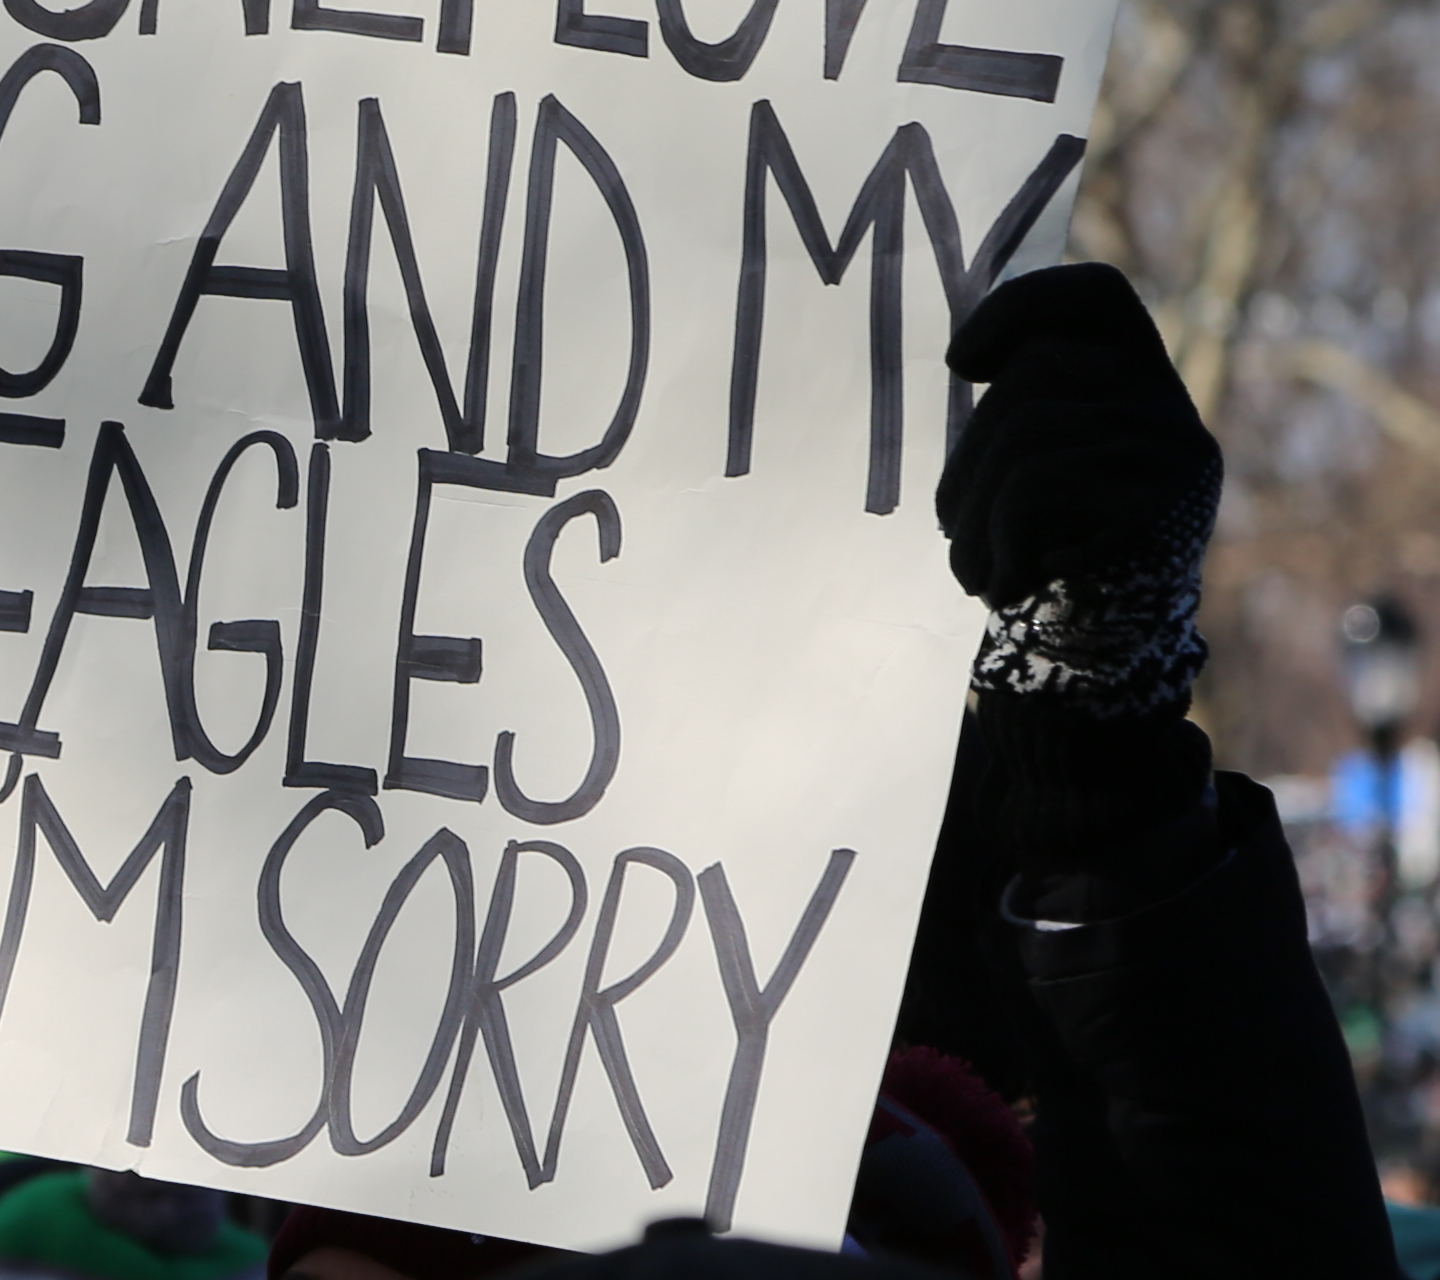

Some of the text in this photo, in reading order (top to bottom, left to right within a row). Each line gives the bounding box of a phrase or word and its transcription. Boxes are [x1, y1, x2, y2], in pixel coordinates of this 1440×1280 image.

[138, 81, 650, 470] AND
[725, 99, 1088, 532] MY
[181, 789, 858, 1234] SORRY
